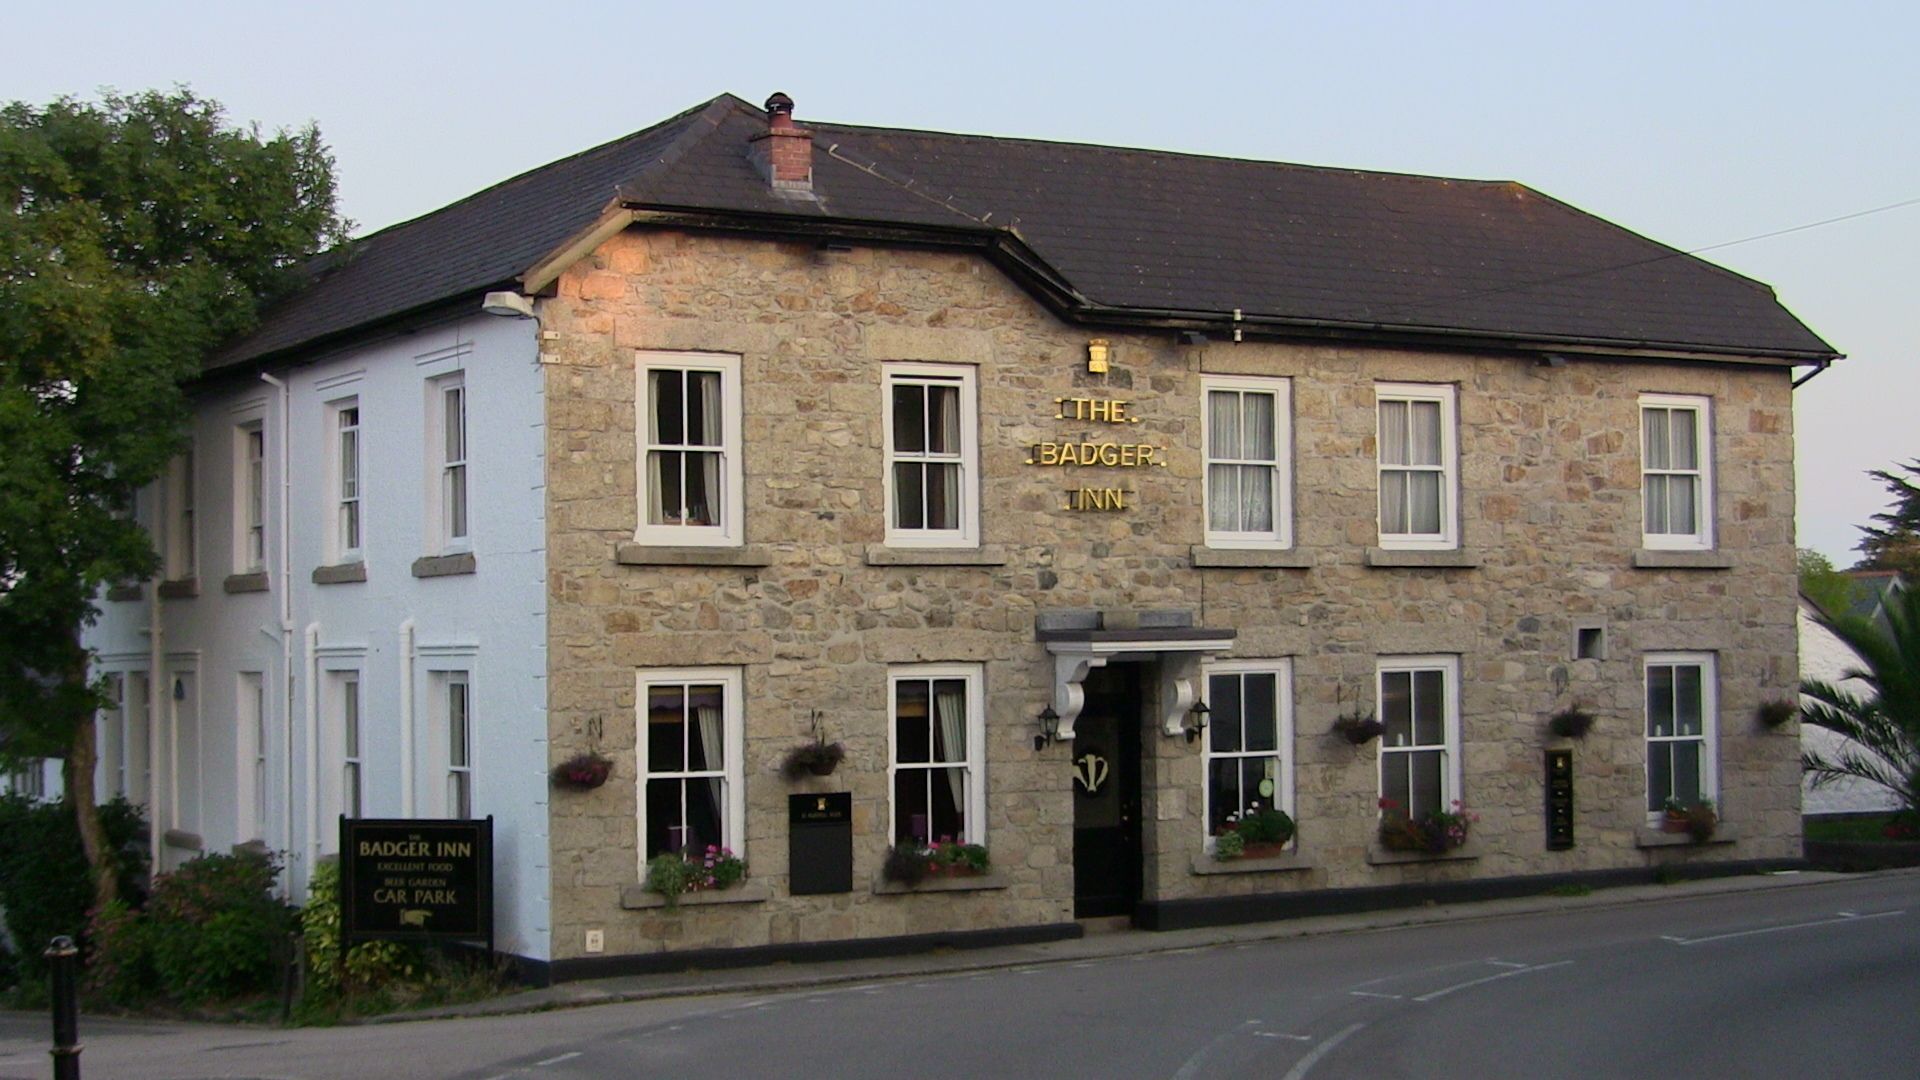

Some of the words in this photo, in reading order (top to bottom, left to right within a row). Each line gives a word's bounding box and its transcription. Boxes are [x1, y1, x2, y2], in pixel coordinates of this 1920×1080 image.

[1071, 398, 1126, 422] THE
[1040, 442, 1154, 466] BADGER
[1077, 488, 1123, 511] INN
[359, 841, 430, 857] BADGER
[437, 842, 471, 857] INN
[377, 863, 425, 872] EXCELLENT
[428, 863, 453, 872] FOOD
[384, 878, 405, 887] BEER
[408, 878, 446, 887] GARDEN
[373, 889, 407, 904] CAR
[415, 890, 456, 904] PARK
